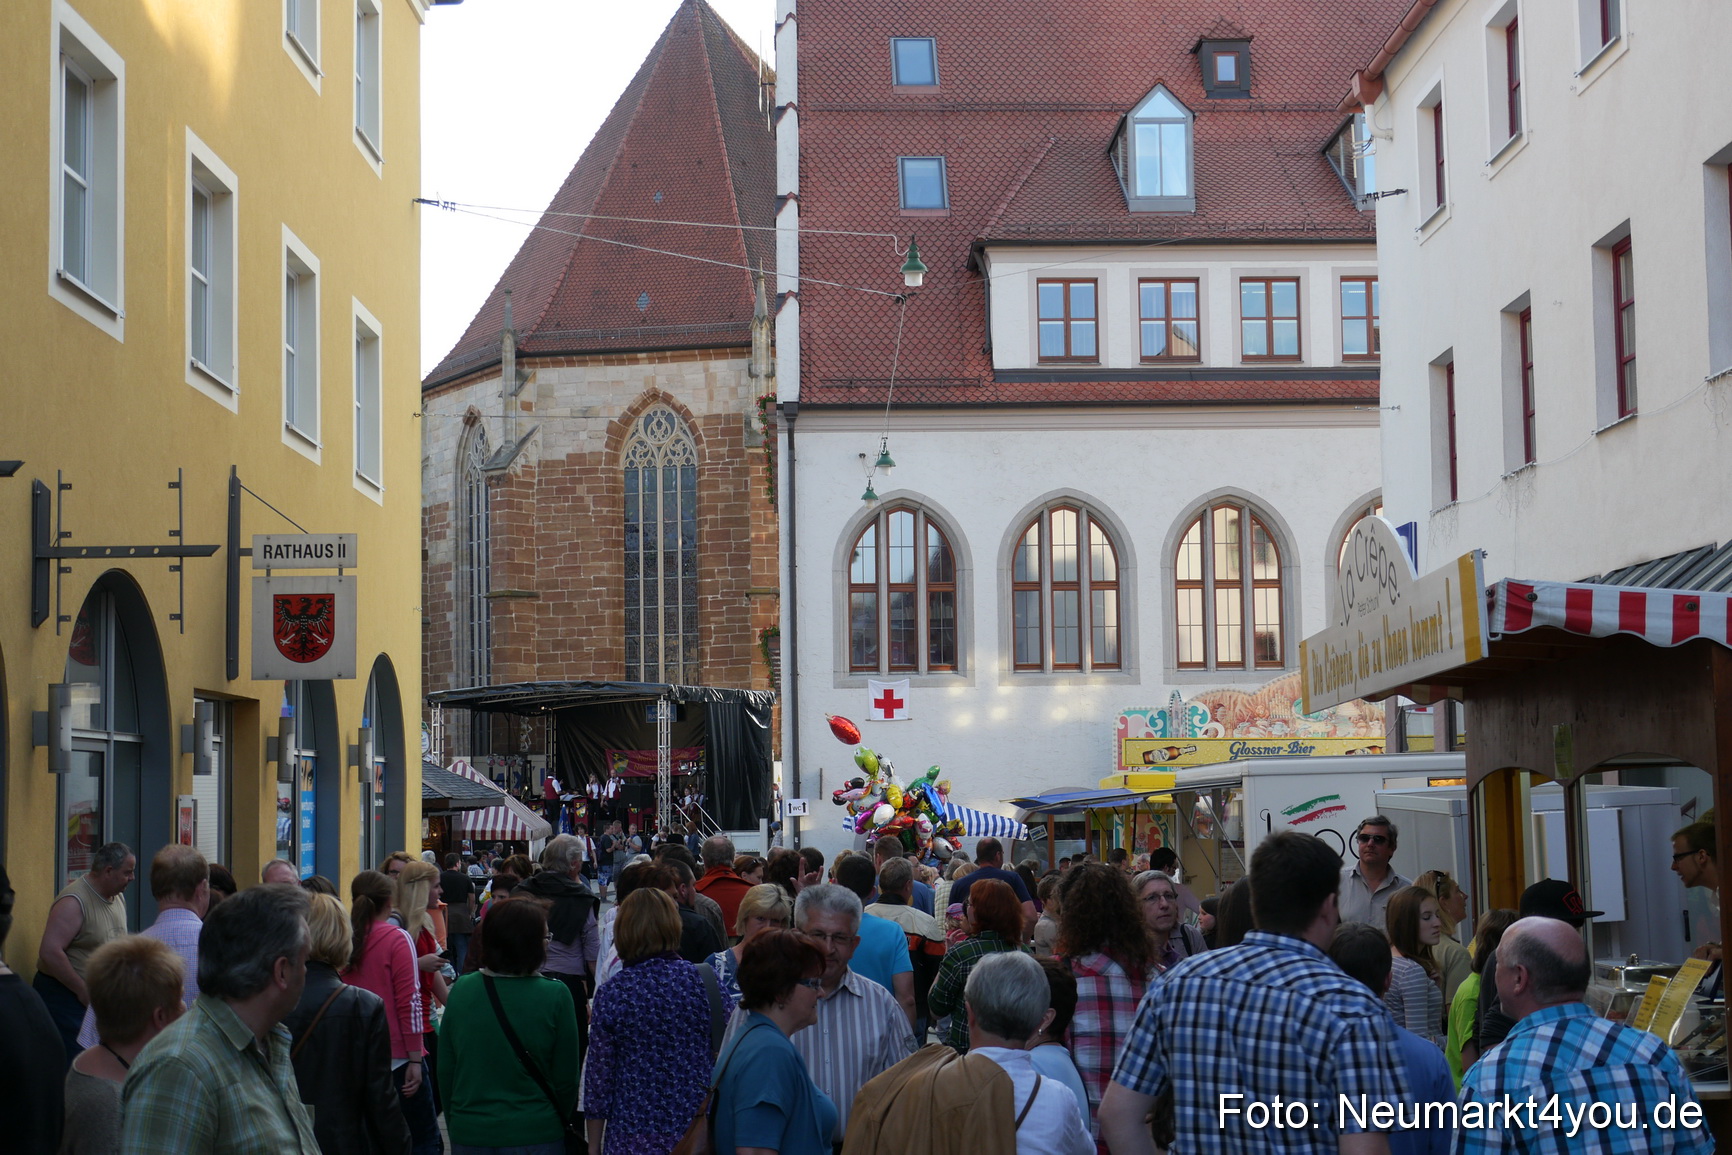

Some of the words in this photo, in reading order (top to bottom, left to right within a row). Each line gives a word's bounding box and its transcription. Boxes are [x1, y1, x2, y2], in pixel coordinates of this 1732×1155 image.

[263, 543, 334, 559] RATHAUS
[337, 543, 346, 558] II
[1340, 565, 1355, 628] La
[1354, 523, 1398, 606] Crêpe
[1312, 648, 1324, 697] Die
[1324, 639, 1358, 703] Crêperie,
[1358, 629, 1370, 680] die
[1371, 637, 1382, 674] zu
[1382, 614, 1409, 671] Ihnen
[1409, 601, 1444, 662] kommt
[1229, 740, 1316, 761] Glossner-Bier
